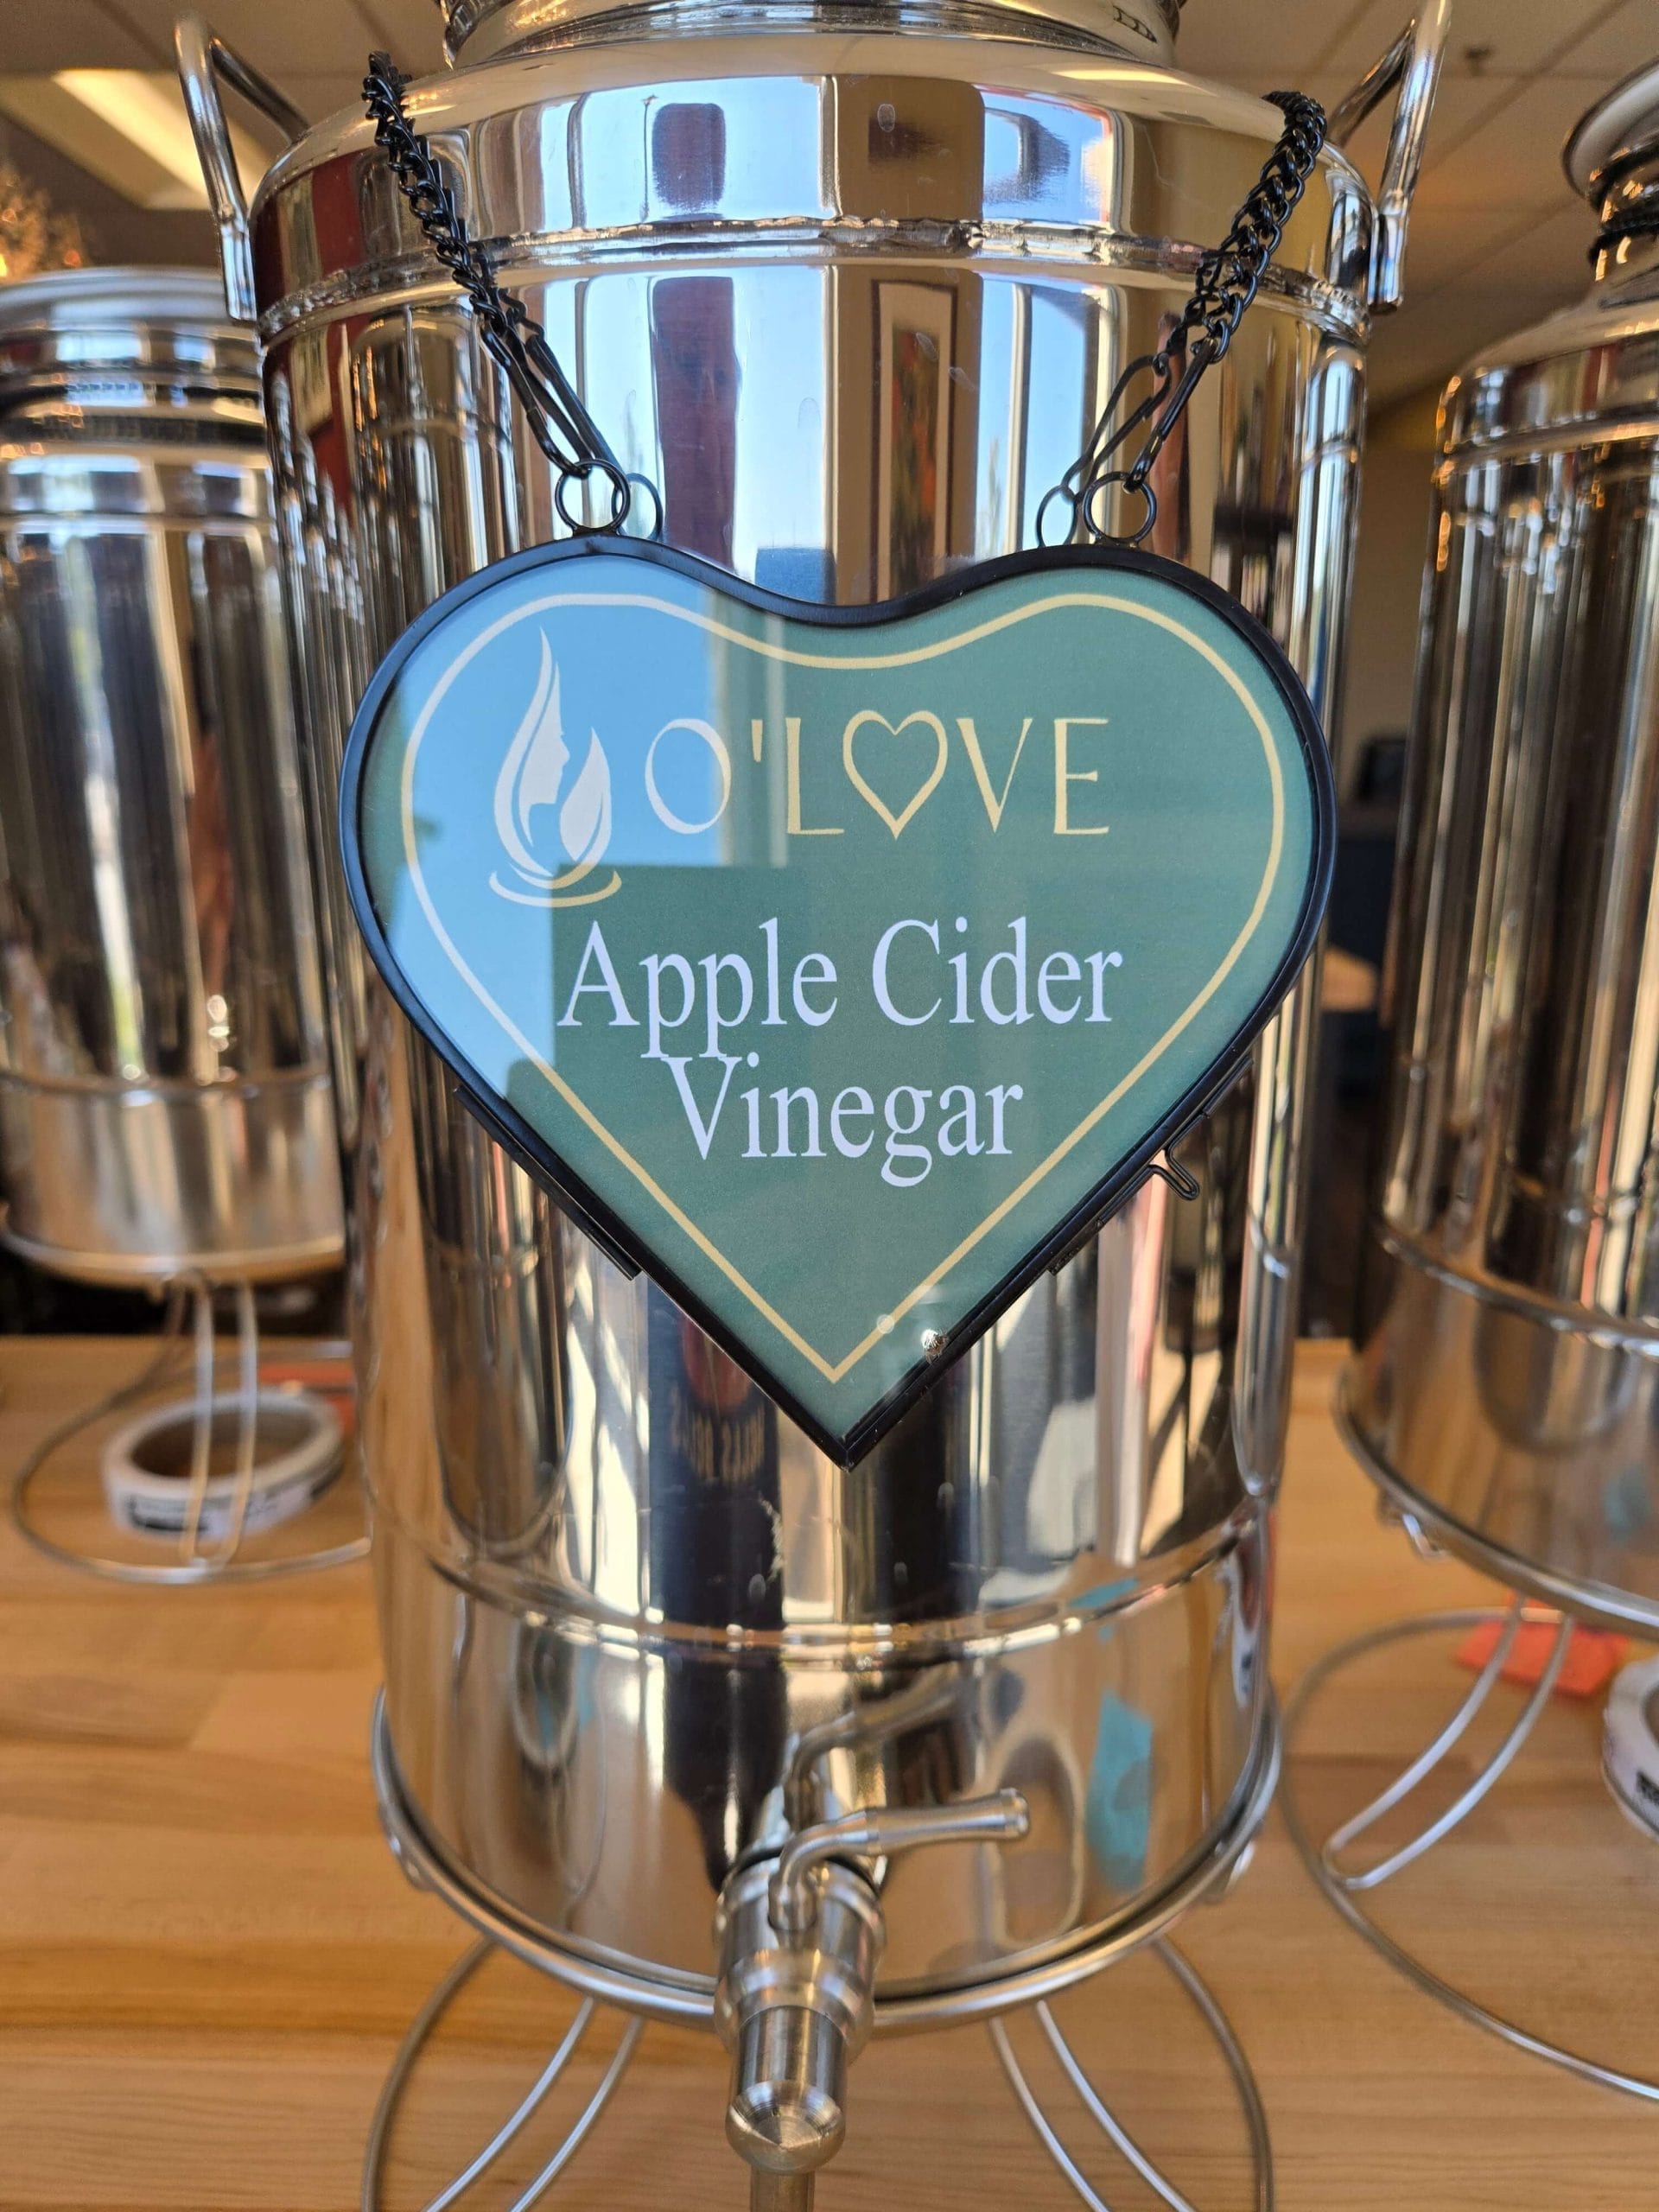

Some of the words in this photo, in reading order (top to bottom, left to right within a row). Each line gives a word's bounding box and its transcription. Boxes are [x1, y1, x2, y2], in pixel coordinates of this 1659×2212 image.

[556, 918, 838, 1058] Apple
[872, 917, 1122, 1026] Cider
[660, 1052, 1023, 1187] Vinegar
